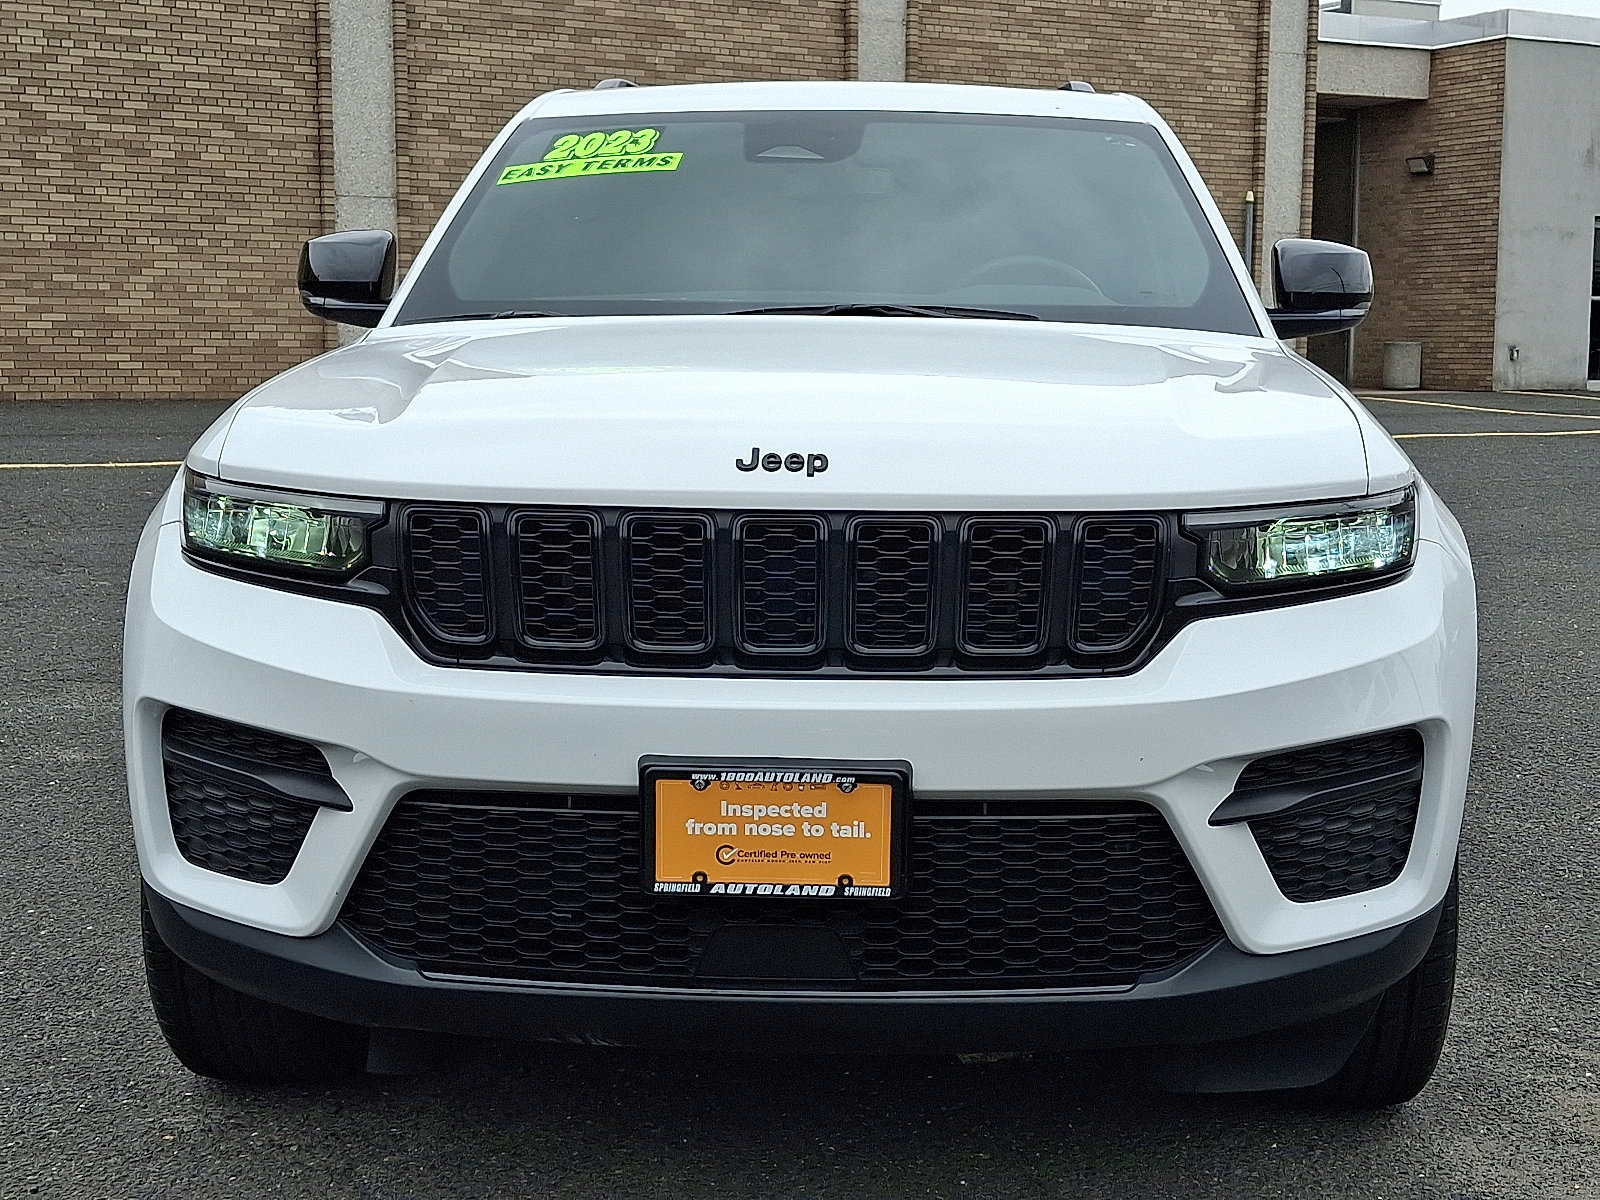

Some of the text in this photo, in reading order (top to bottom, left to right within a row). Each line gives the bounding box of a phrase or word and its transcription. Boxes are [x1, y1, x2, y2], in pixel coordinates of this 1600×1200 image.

[544, 128, 660, 161] 2023
[502, 155, 674, 181] EASY TERMS
[735, 447, 829, 477] Jeep
[720, 801, 827, 820] Inspected
[686, 819, 872, 839] from nose to tail.
[737, 850, 778, 859] Certified
[654, 882, 892, 898] SPRINGFIELD AUTOLAND SPRINGFIELD
